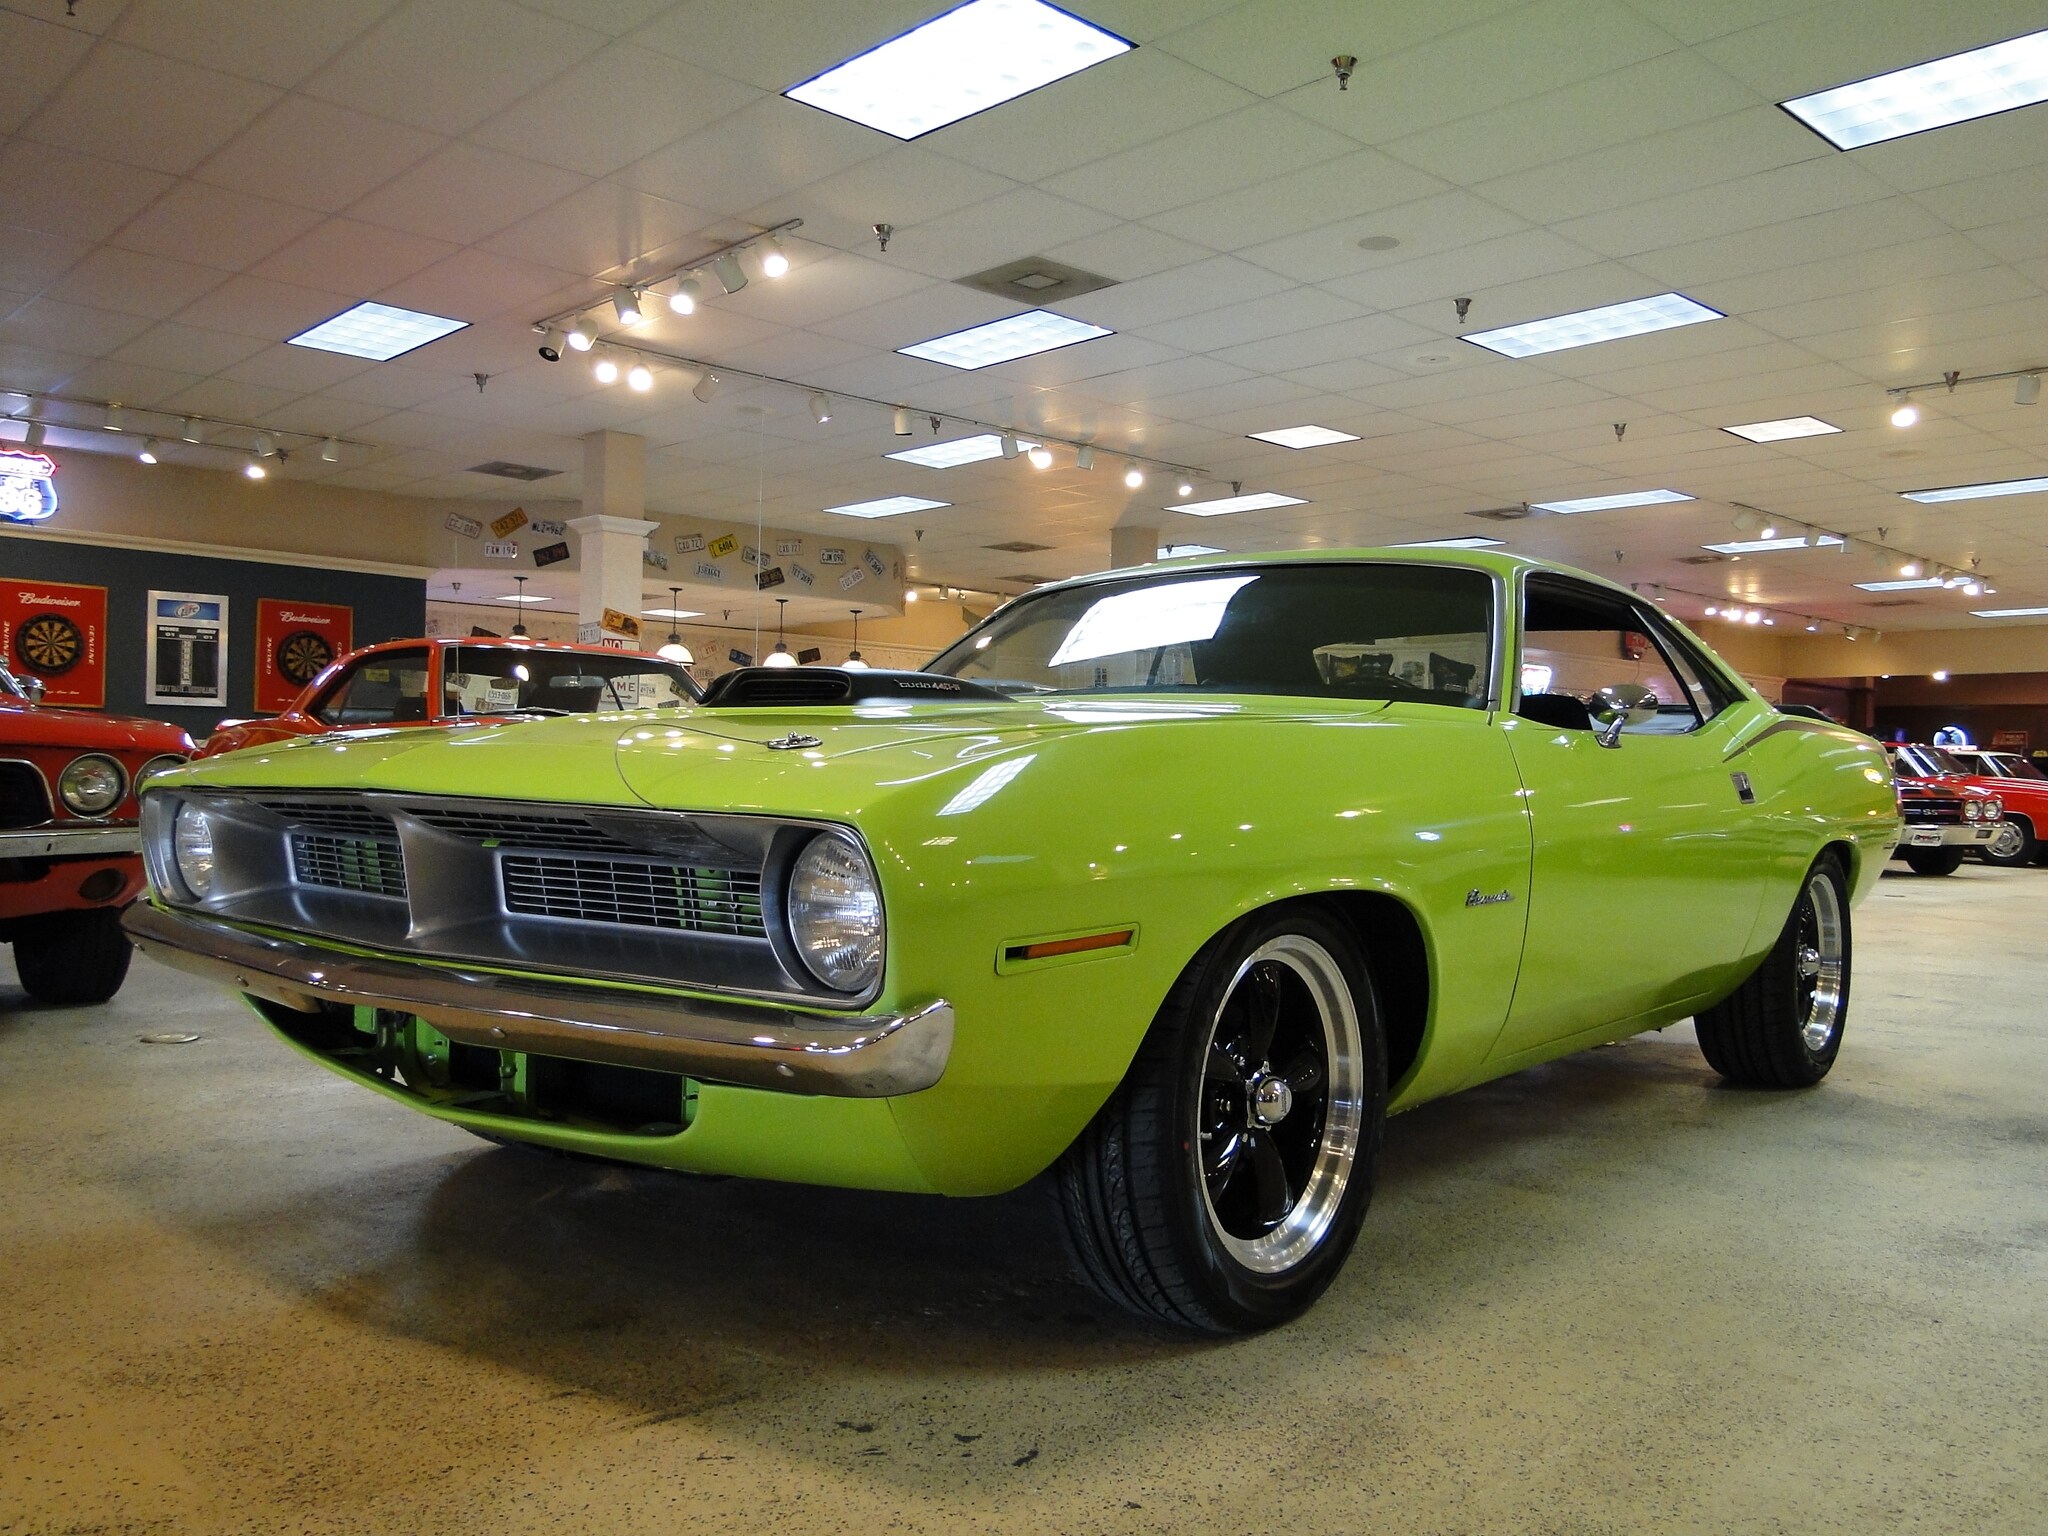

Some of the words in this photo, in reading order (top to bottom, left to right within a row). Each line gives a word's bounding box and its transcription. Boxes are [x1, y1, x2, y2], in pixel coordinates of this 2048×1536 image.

[18, 591, 81, 607] Budweiser
[280, 611, 331, 624] Budweiser
[265, 637, 273, 675] GENUINE
